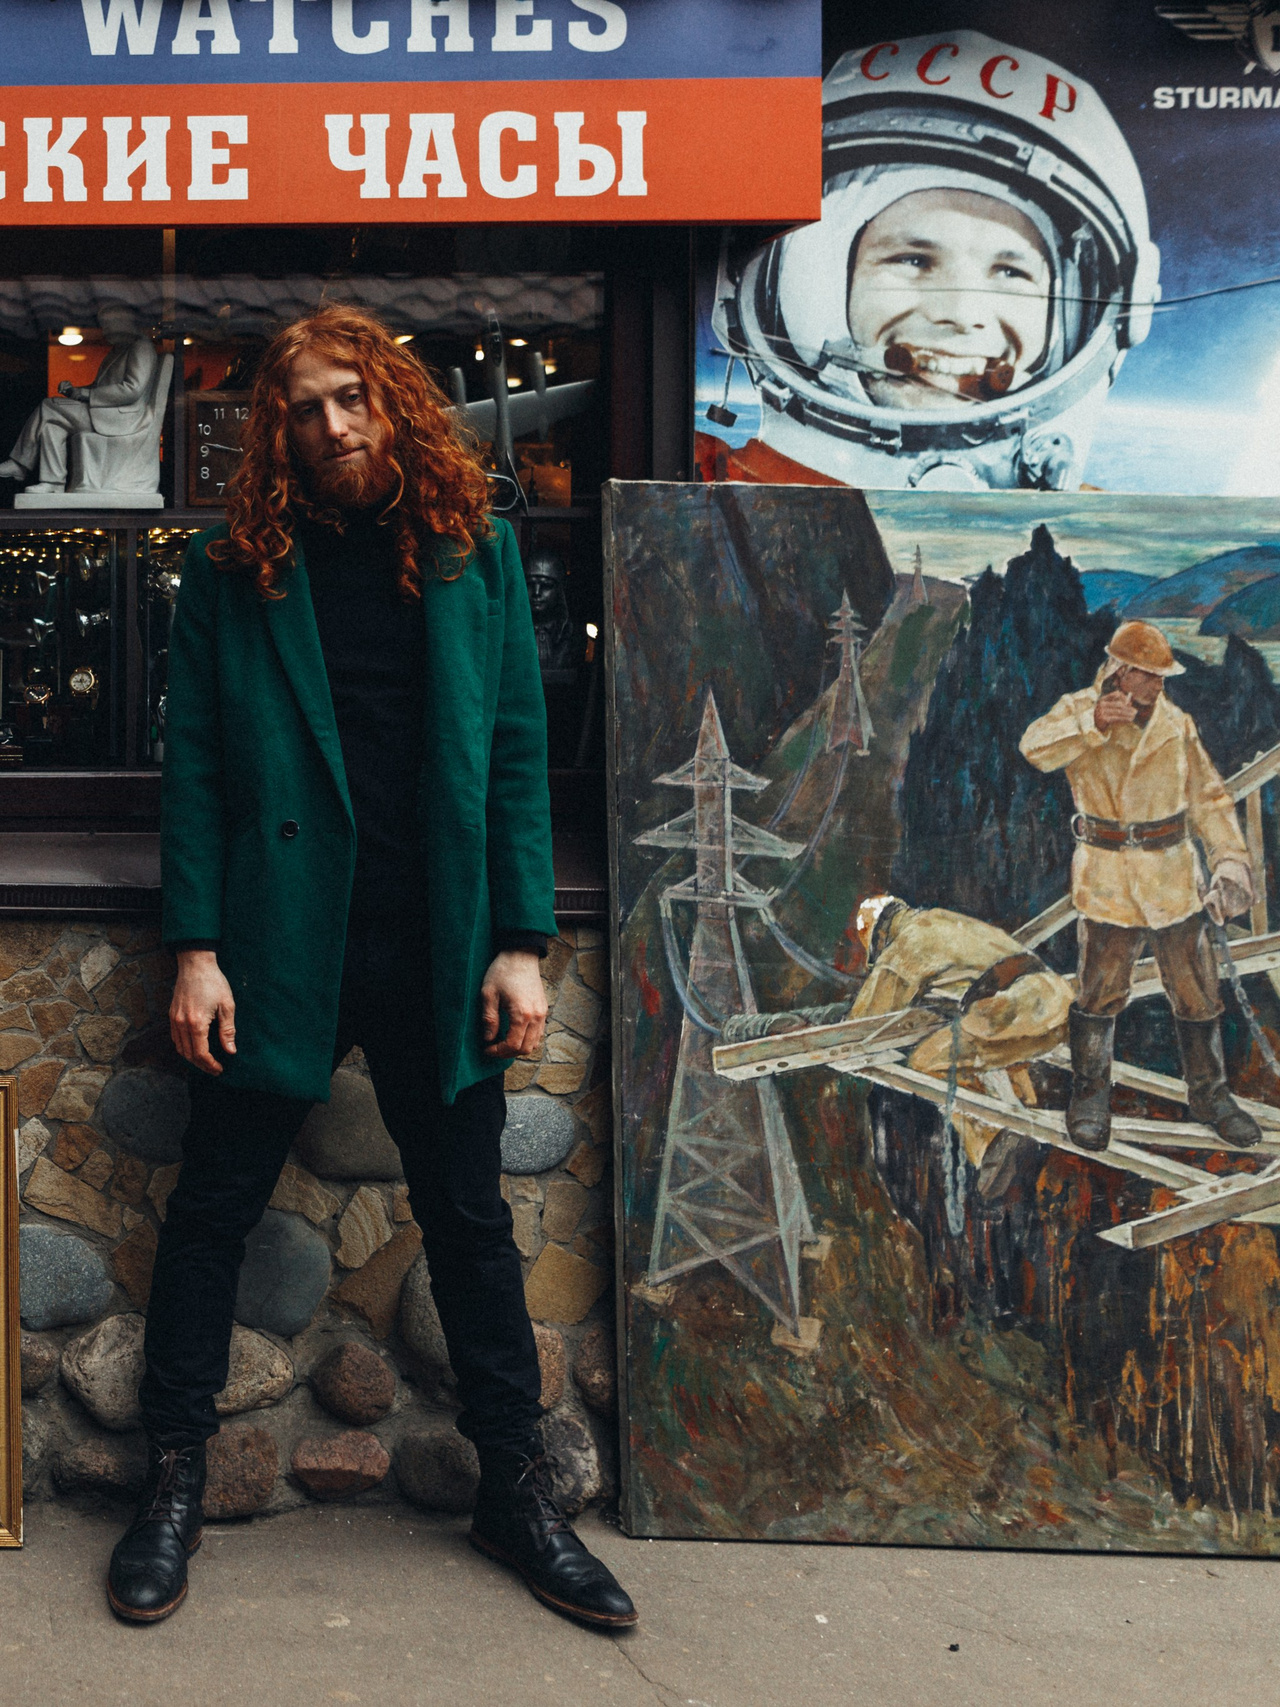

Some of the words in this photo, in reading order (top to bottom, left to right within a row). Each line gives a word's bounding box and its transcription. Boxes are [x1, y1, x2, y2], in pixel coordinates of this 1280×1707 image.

[81, 0, 628, 56] WATCHES
[1153, 86, 1280, 110] STURM
[324, 110, 648, 199] ЧАСЫ
[213, 407, 225, 420] 11
[234, 407, 249, 420] 12
[198, 423, 212, 436] 10
[200, 445, 210, 458] 9
[200, 466, 210, 480] 8
[216, 482, 226, 496] 7
